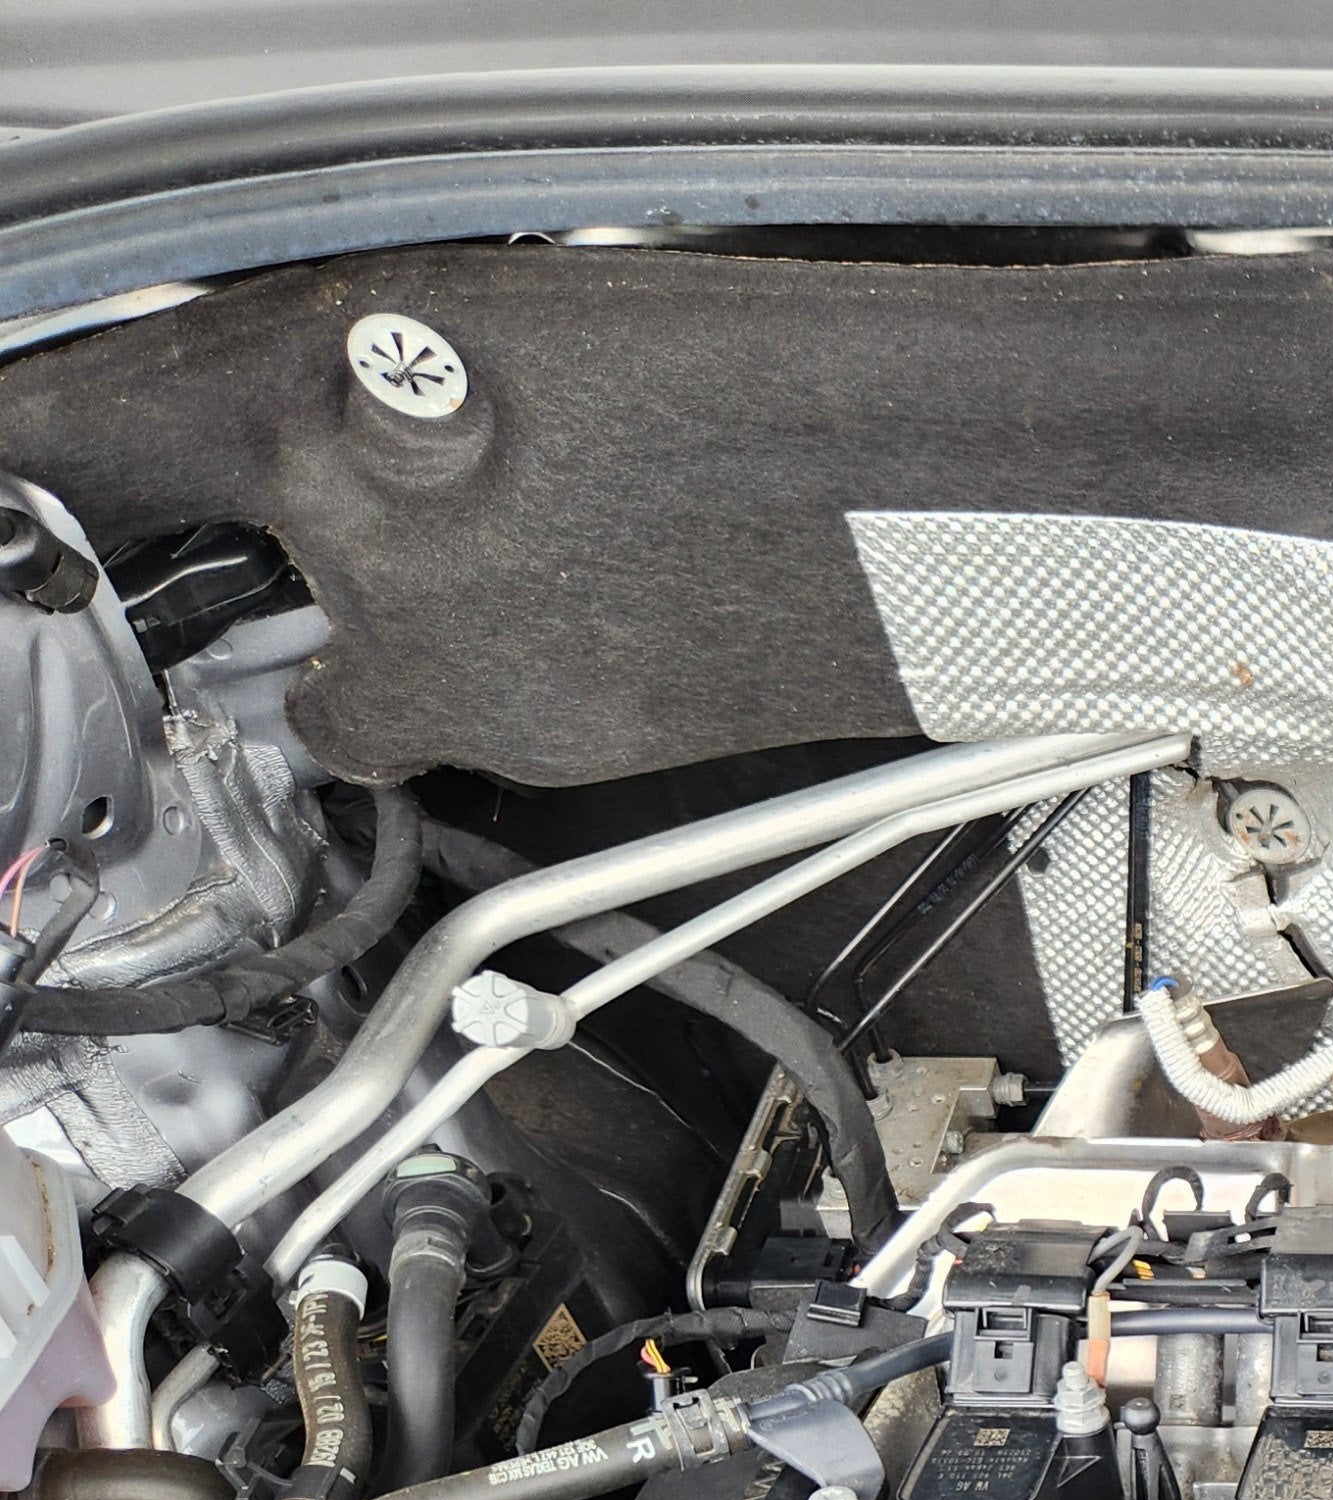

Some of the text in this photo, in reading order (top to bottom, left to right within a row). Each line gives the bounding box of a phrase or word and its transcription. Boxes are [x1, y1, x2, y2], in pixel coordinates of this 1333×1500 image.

[556, 1453, 580, 1470] AG
[580, 1446, 608, 1465] VW
[956, 1480, 988, 1490] VW AG
